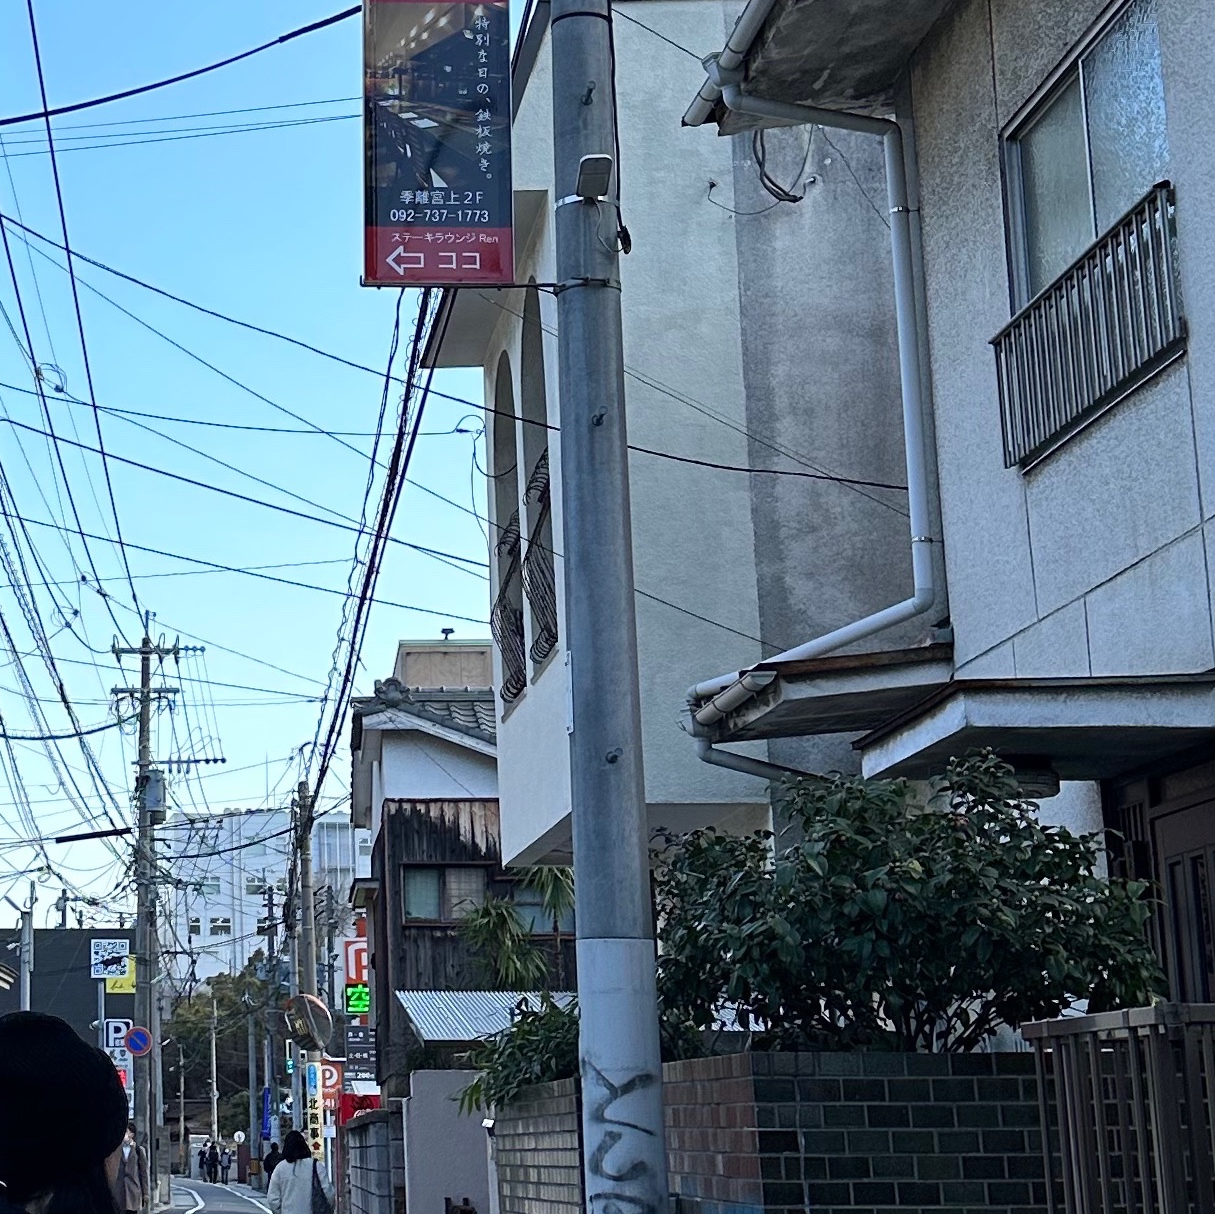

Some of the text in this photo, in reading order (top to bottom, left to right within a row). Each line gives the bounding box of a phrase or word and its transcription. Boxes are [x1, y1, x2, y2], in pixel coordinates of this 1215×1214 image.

[390, 209, 489, 223] 092-737-1773
[391, 232, 499, 243] ステーキラウンジ Ren
[438, 252, 481, 269] ココ
[108, 1022, 127, 1046] P
[308, 1097, 320, 1140] 北商事
